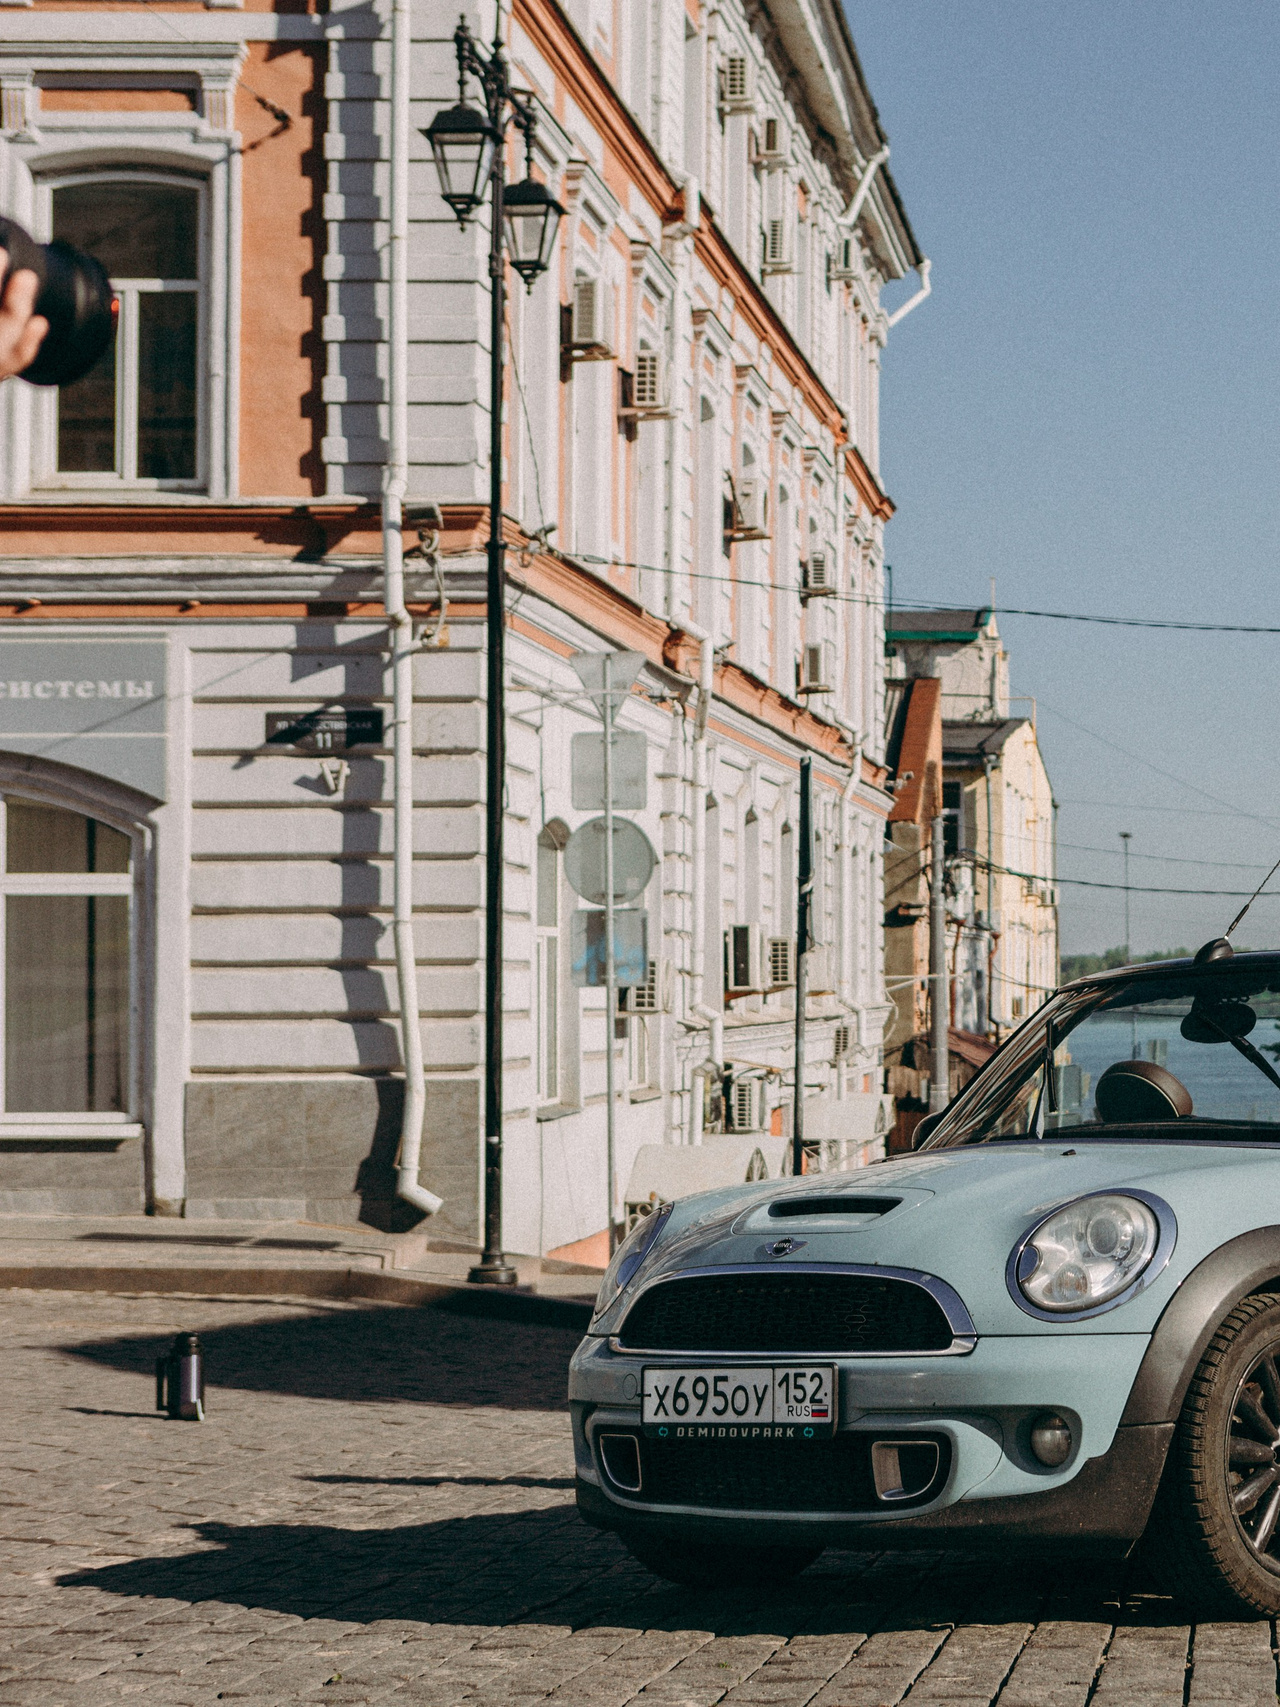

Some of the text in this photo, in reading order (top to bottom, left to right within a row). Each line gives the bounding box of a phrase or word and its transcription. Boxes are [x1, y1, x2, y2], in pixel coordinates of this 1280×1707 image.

[316, 732, 332, 749] 11
[777, 1372, 823, 1404] 152
[787, 1405, 810, 1417] RUS
[676, 1427, 795, 1438] DEMIDOVPARK
